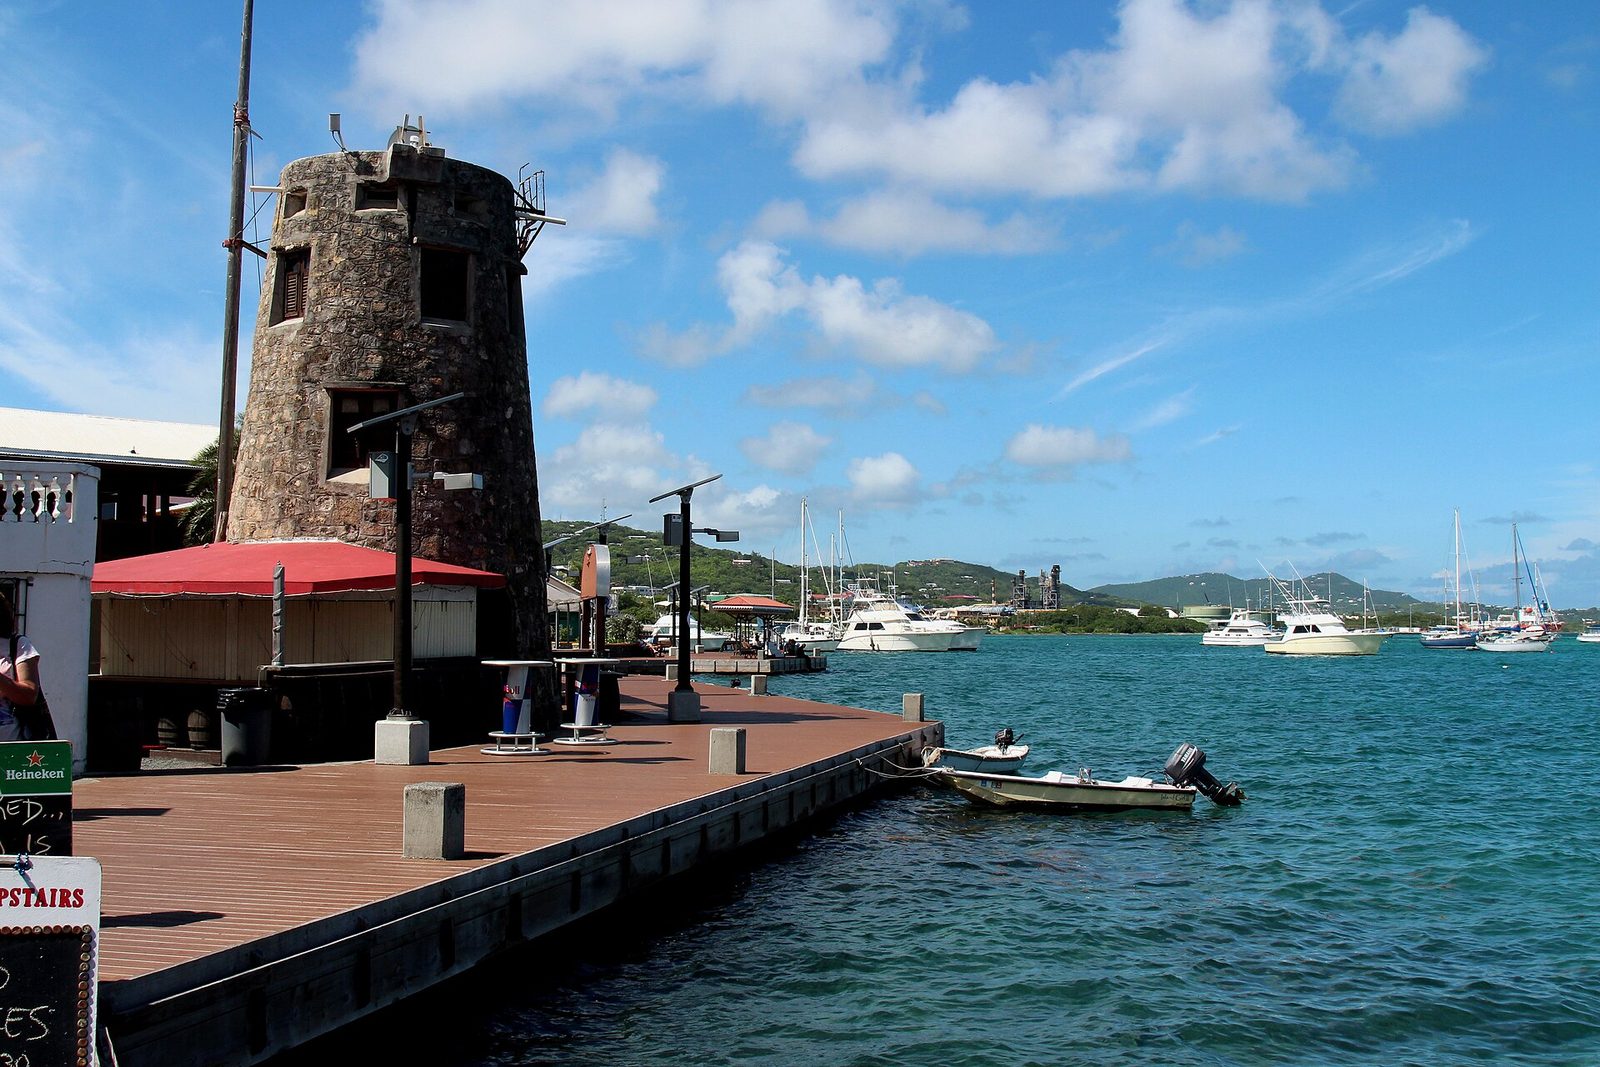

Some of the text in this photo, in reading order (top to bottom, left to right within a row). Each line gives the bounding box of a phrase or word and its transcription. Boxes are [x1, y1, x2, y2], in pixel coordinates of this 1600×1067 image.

[6, 768, 65, 780] Heineken
[27, 833, 51, 855] IS
[0, 1005, 49, 1041] ES
